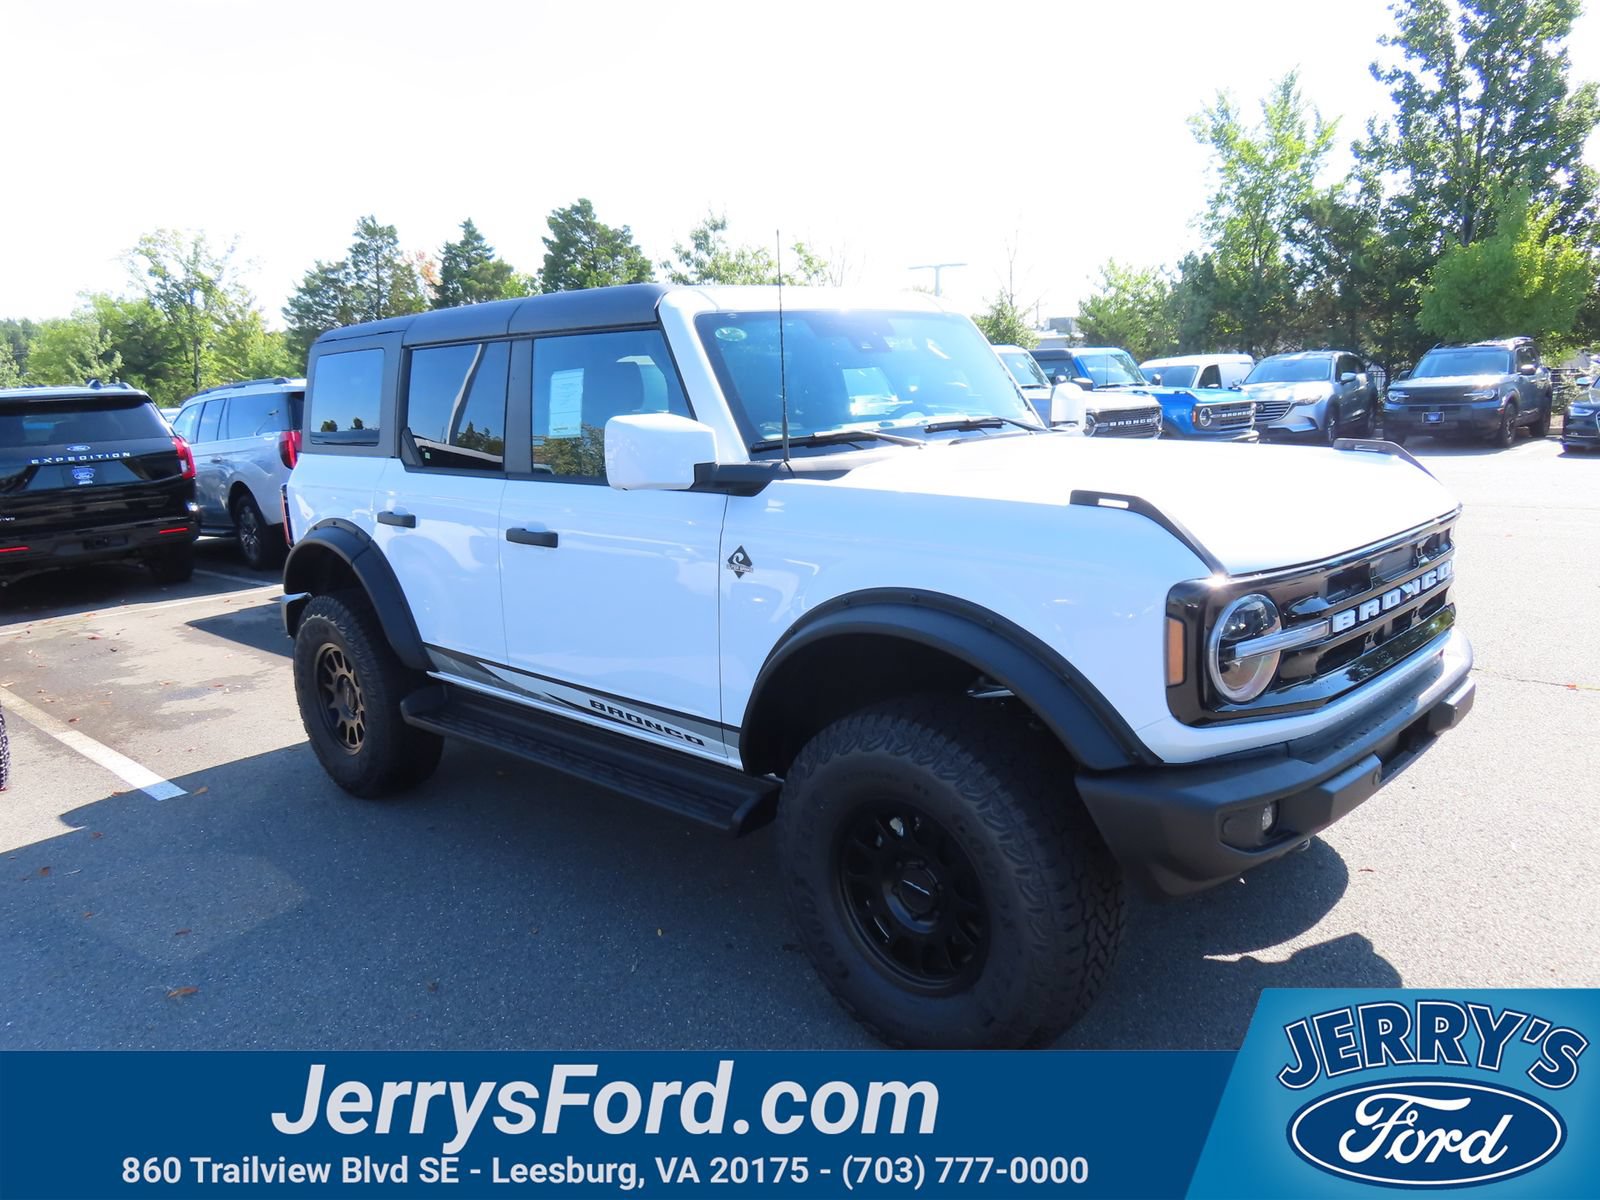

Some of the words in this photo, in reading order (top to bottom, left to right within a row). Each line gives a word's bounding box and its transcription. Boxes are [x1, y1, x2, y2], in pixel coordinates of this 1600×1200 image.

[31, 452, 130, 464] EXPEDITION
[1332, 559, 1453, 633] BRONCO
[589, 699, 705, 746] BRONCO
